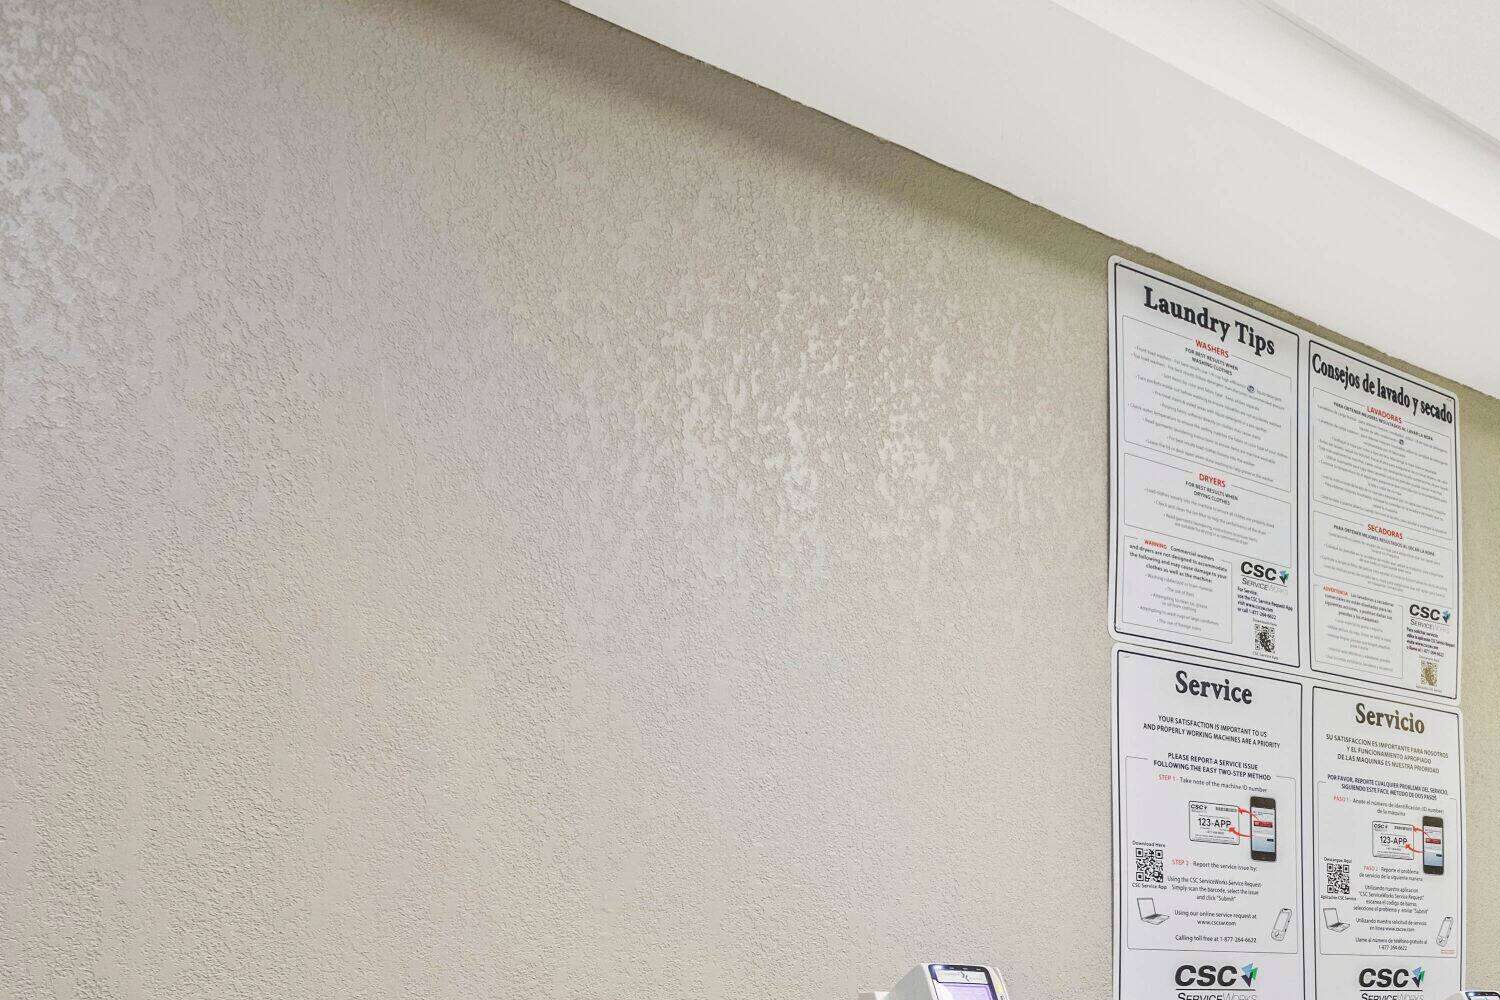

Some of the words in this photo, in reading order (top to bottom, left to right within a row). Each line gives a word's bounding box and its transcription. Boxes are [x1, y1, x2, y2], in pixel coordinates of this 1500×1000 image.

[1144, 285, 1230, 342] Laundry
[1235, 319, 1274, 358] Tips
[1195, 339, 1228, 358] WASHERS
[1312, 351, 1359, 395] Consejos
[1362, 371, 1374, 396] de
[1377, 377, 1410, 409] lavado
[1412, 396, 1418, 417] y
[1420, 394, 1452, 425] secado
[1367, 405, 1401, 424] LAVADORAS
[1199, 473, 1225, 487] DRYERS
[1368, 524, 1401, 540] SECADORAS
[1144, 539, 1166, 549] WARNING
[1170, 545, 1196, 557] Commercial
[1197, 552, 1214, 561] washers
[1241, 560, 1276, 581] CSC
[1409, 602, 1440, 622] CSC
[1175, 669, 1252, 705] Service
[1158, 715, 1173, 723] YOUR
[1175, 717, 1213, 729] SATISFACTION
[1220, 724, 1250, 735] IMPORTANT
[1355, 702, 1424, 734] Servicio
[1143, 722, 1155, 730] AND
[1156, 724, 1184, 735] PROPERLY
[1186, 729, 1212, 739] WORKING
[1213, 733, 1240, 743] MACHINES
[1257, 739, 1280, 748] PRIORITY
[1357, 747, 1403, 760] FUNCIONAMIENTO
[1404, 754, 1431, 764] APROPIADO
[1378, 741, 1409, 752] IMPORTANTE
[1424, 749, 1447, 758] NOSOTROS
[1153, 760, 1188, 770] FOLLOWING
[1218, 768, 1246, 777] TWO-STEP
[1247, 772, 1271, 780] METHOD
[1168, 752, 1188, 761] PLEASE
[1190, 755, 1212, 764] REPORT
[1219, 759, 1241, 768] SERVICE
[1391, 761, 1412, 769] NUESTRA
[1414, 765, 1439, 773] PRIORIDAD
[1220, 781, 1240, 789] machine
[1198, 817, 1231, 828] 123-APP
[1379, 835, 1407, 846] 123-APP
[1174, 964, 1237, 986] CSC
[1358, 967, 1408, 987] CSC
